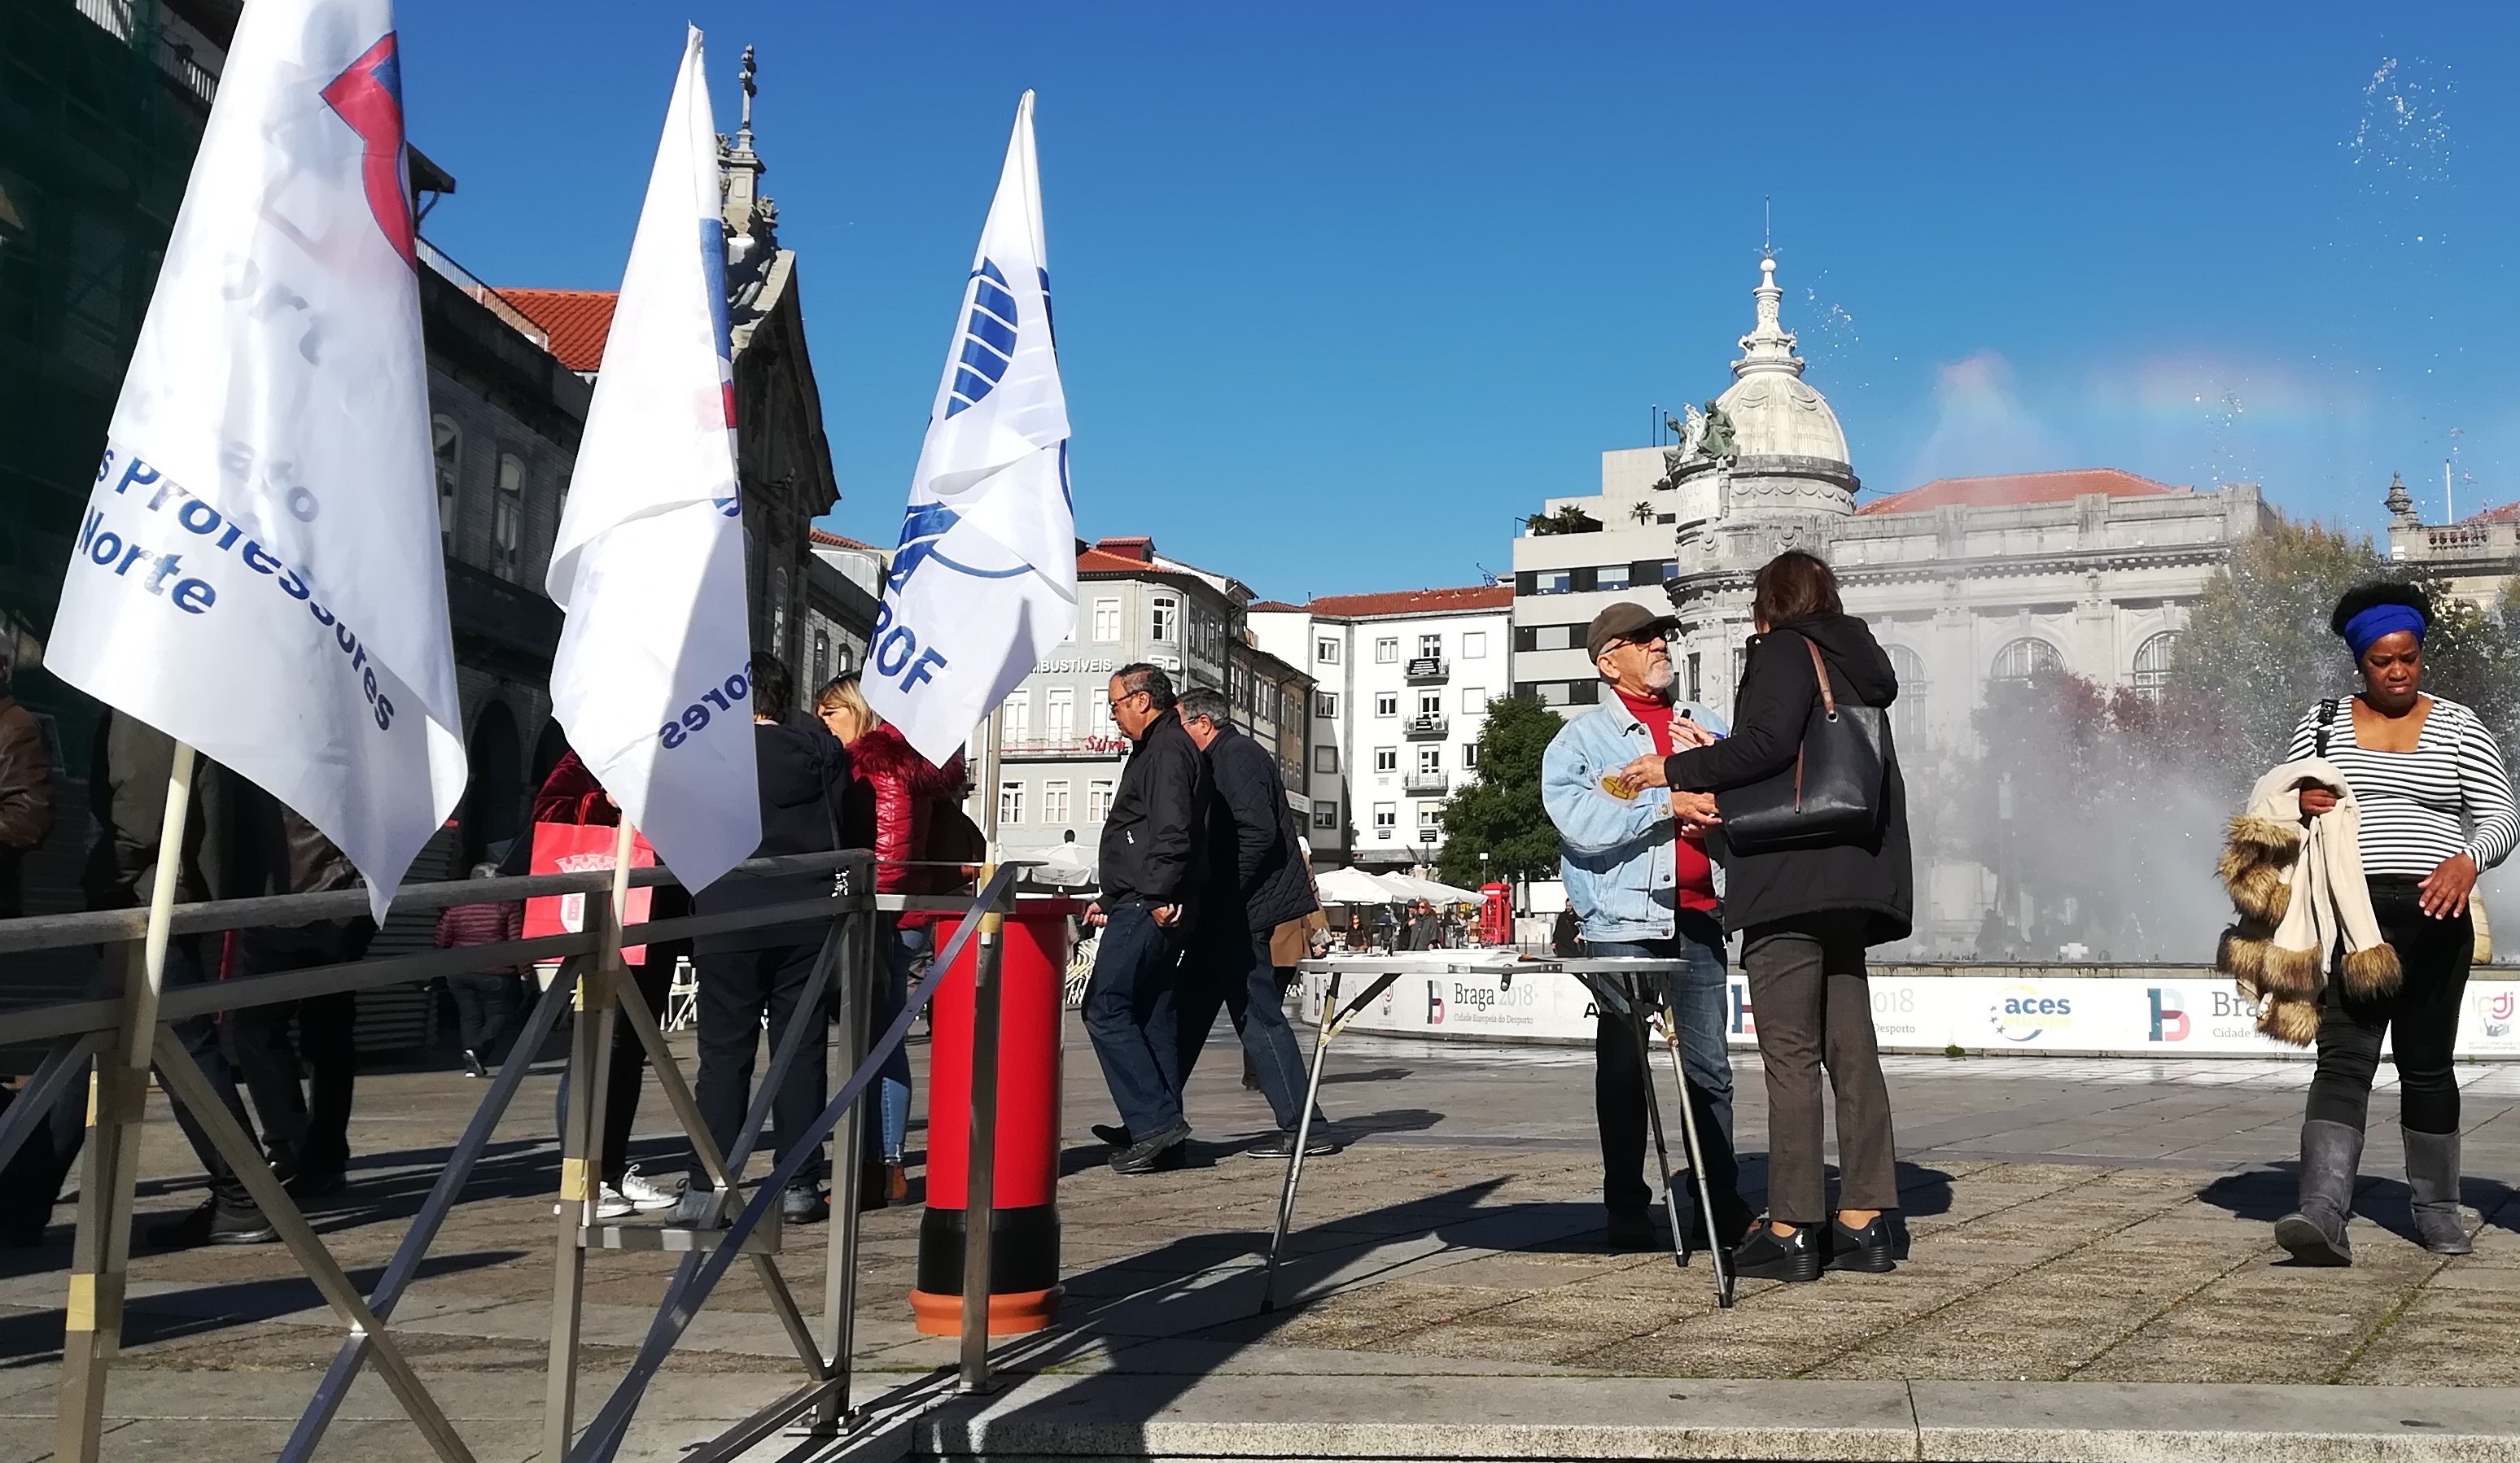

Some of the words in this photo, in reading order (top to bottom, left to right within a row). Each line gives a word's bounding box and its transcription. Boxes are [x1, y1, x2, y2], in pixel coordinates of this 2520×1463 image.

[77, 504, 217, 614] Norte
[1455, 983, 1494, 1011] Braga
[1498, 983, 1533, 1006] 2018
[1872, 988, 1914, 1013] 018
[2004, 998, 2072, 1015] aces
[2212, 990, 2260, 1018] Bra
[1454, 1012, 1472, 1022] Cidade
[1498, 1014, 1506, 1023] do
[1507, 1015, 1533, 1026] Desporto
[2212, 1027, 2251, 1038] Cidade
